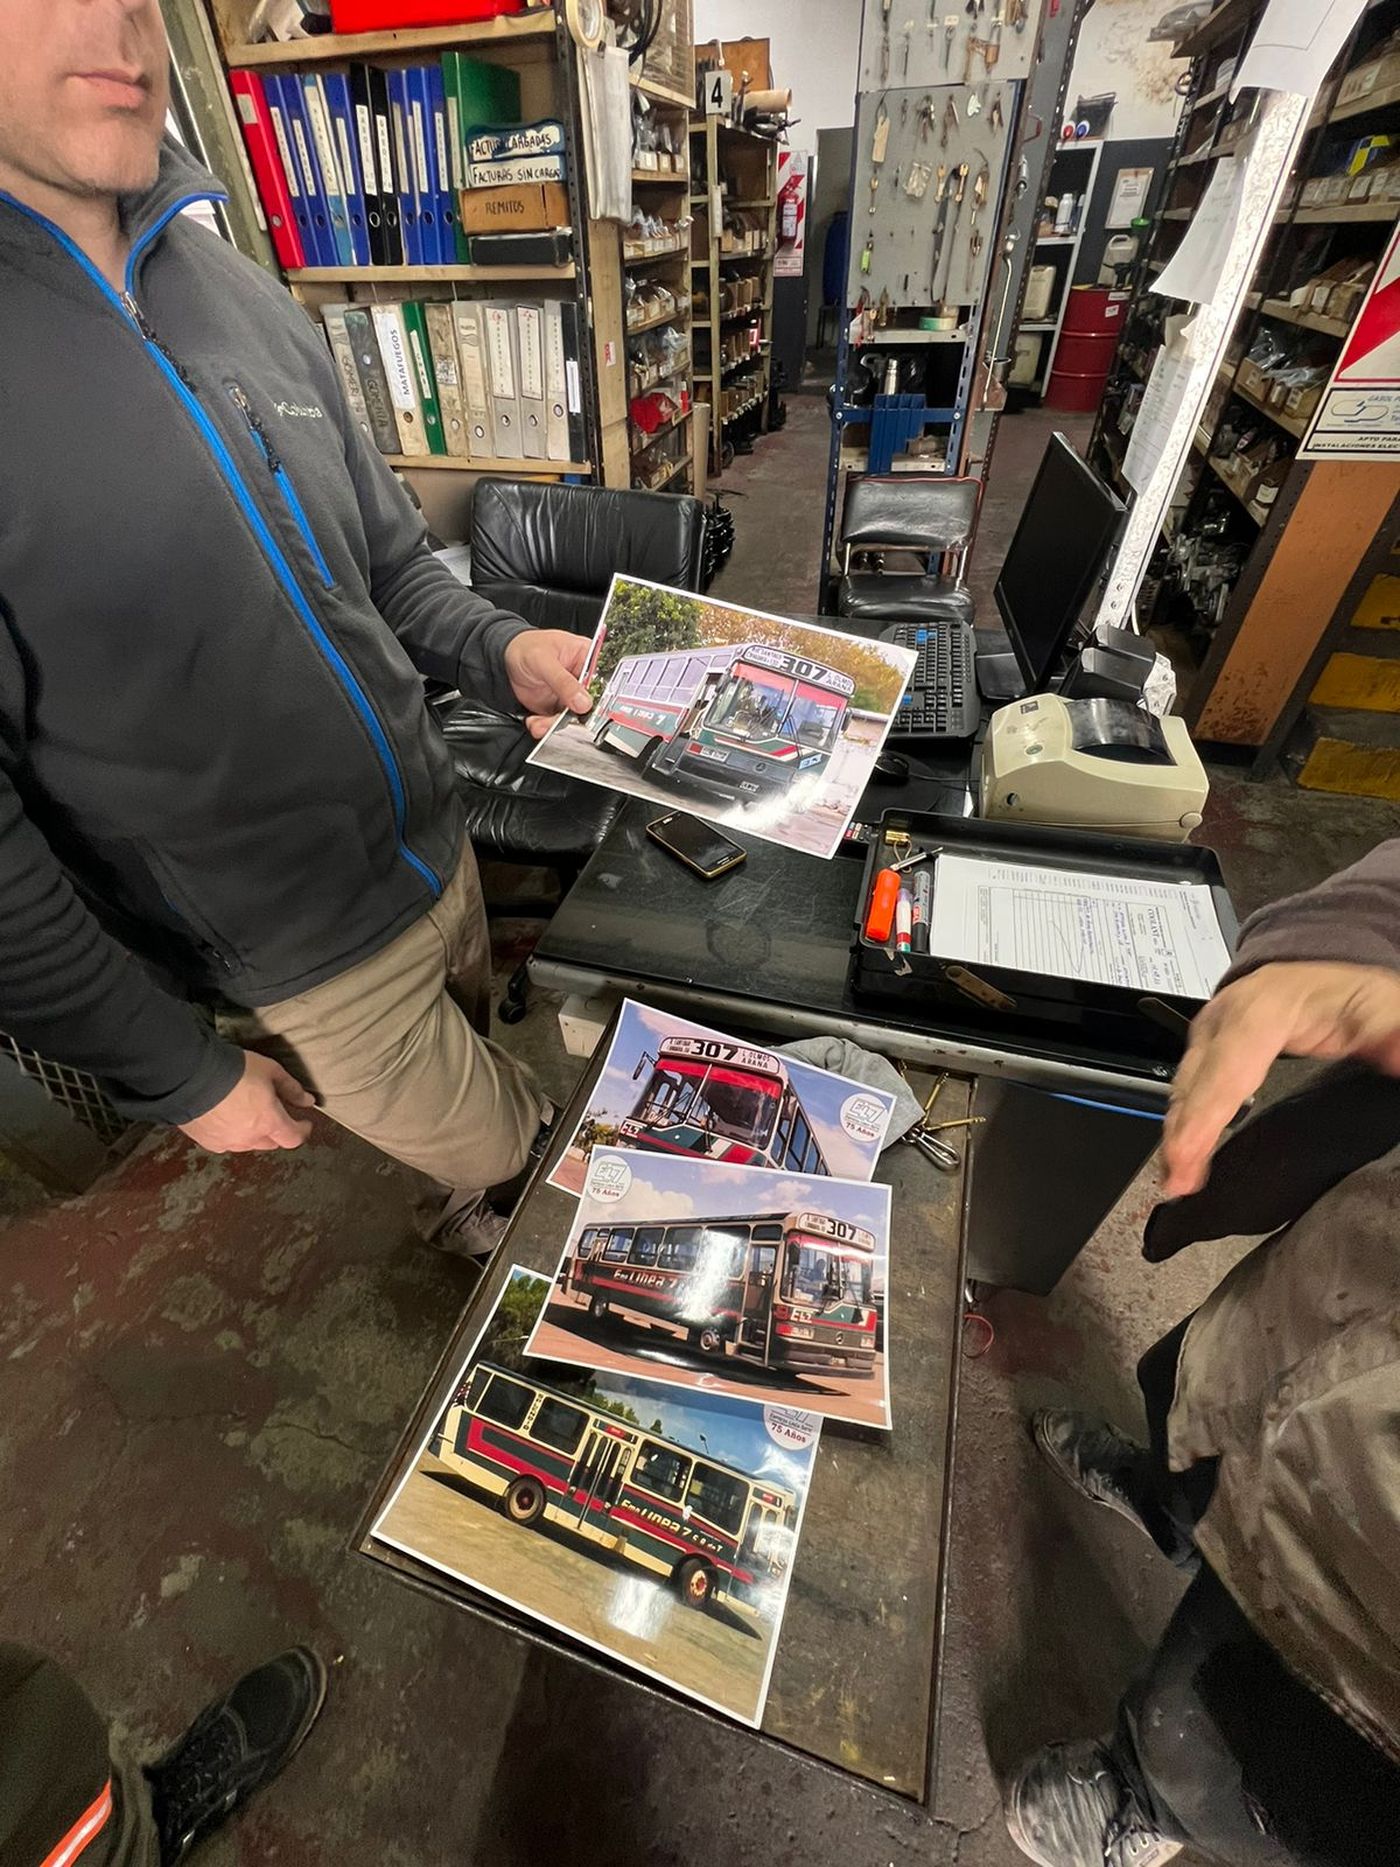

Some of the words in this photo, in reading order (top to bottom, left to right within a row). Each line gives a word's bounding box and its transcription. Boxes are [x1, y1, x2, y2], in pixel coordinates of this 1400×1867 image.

[711, 77, 723, 108] 4
[473, 167, 513, 184] FACTURAS
[517, 167, 533, 181] SIN
[485, 200, 525, 215] REMITOS
[390, 329, 411, 396] MATAFUEGOS
[780, 656, 828, 681] 307
[691, 1039, 739, 1060] 307
[742, 1057, 769, 1069] ARANA
[826, 1219, 857, 1241] 307
[771, 1422, 783, 1433] 75
[784, 1428, 806, 1443] Años
